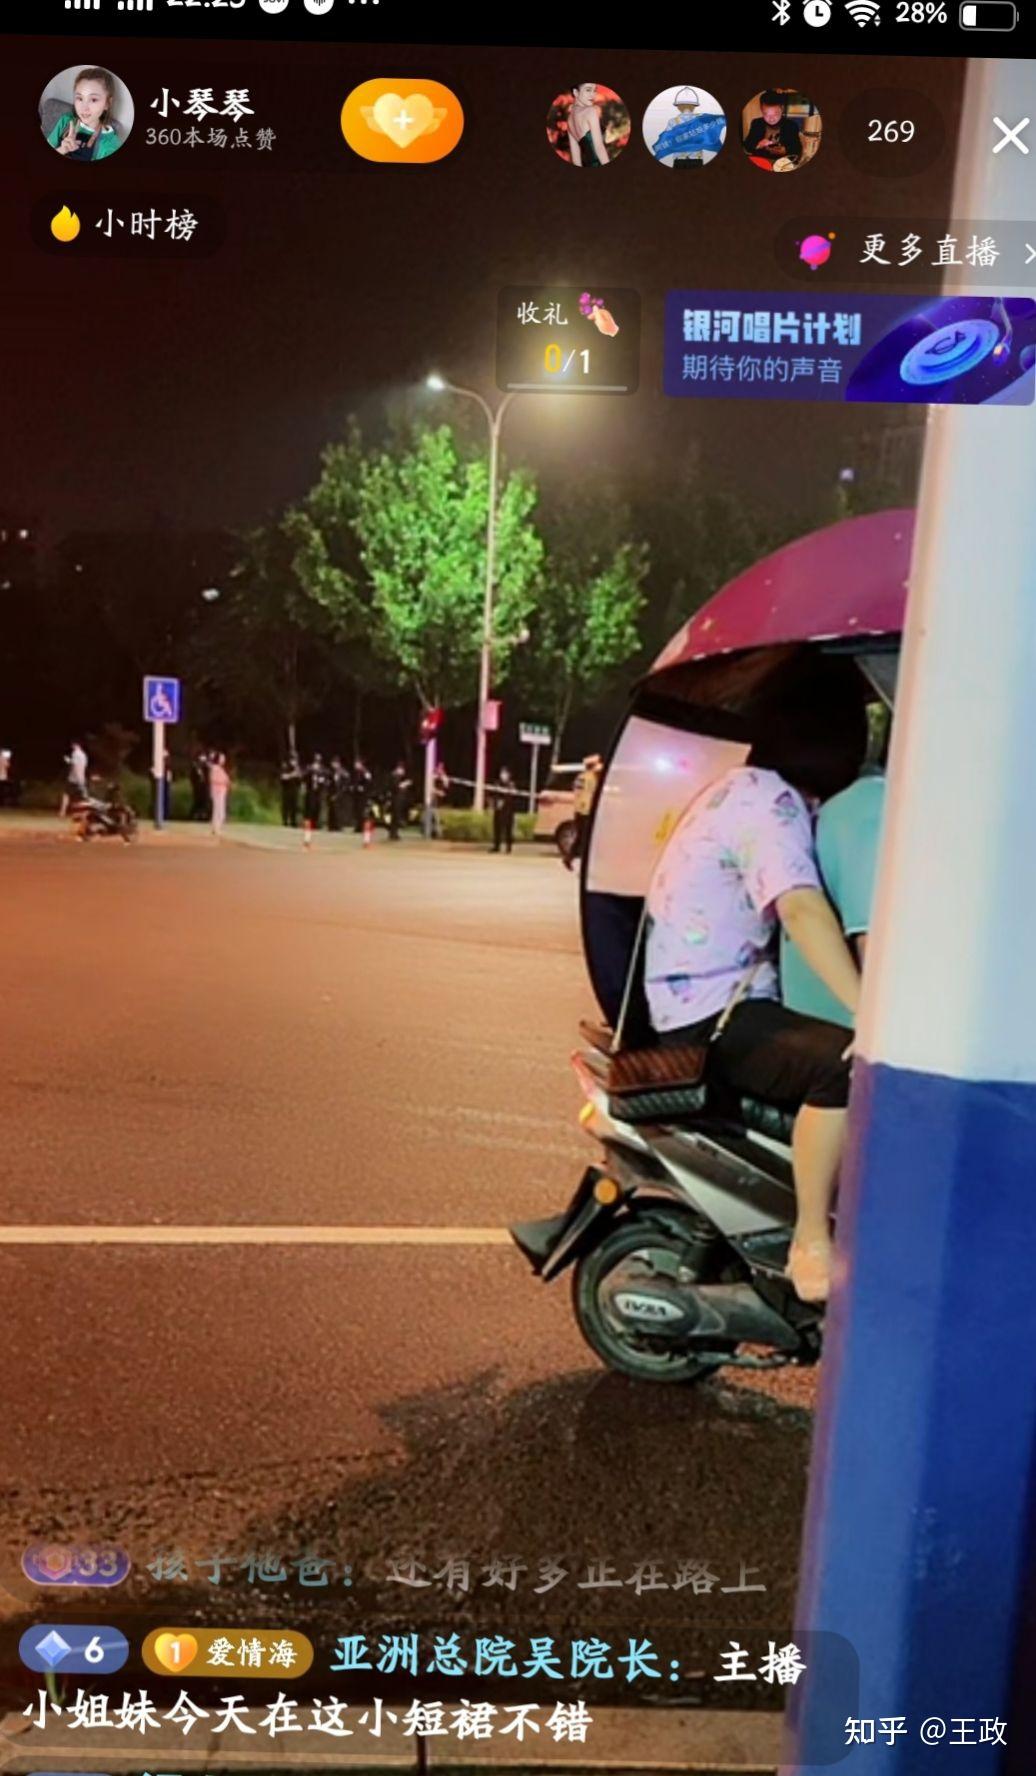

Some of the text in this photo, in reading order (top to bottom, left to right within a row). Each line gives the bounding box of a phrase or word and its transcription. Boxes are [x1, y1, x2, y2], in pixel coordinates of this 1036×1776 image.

[896, 1, 948, 24] 28%
[150, 87, 255, 122] 小琴琴
[145, 126, 277, 151] 360本场点赞
[868, 119, 915, 143] 269
[95, 208, 199, 242] 小时榜
[860, 233, 1001, 268] 更多直播
[516, 302, 568, 327] 收礼
[683, 309, 861, 346] 银河唱片计划
[543, 343, 590, 375] 0/1
[682, 354, 842, 384] 期待你的声音
[84, 1636, 104, 1663] 6
[170, 1641, 182, 1663] 1
[207, 1637, 298, 1668] 爱情海
[22, 1689, 594, 1741] 小姐妹今天在这小短裙不错
